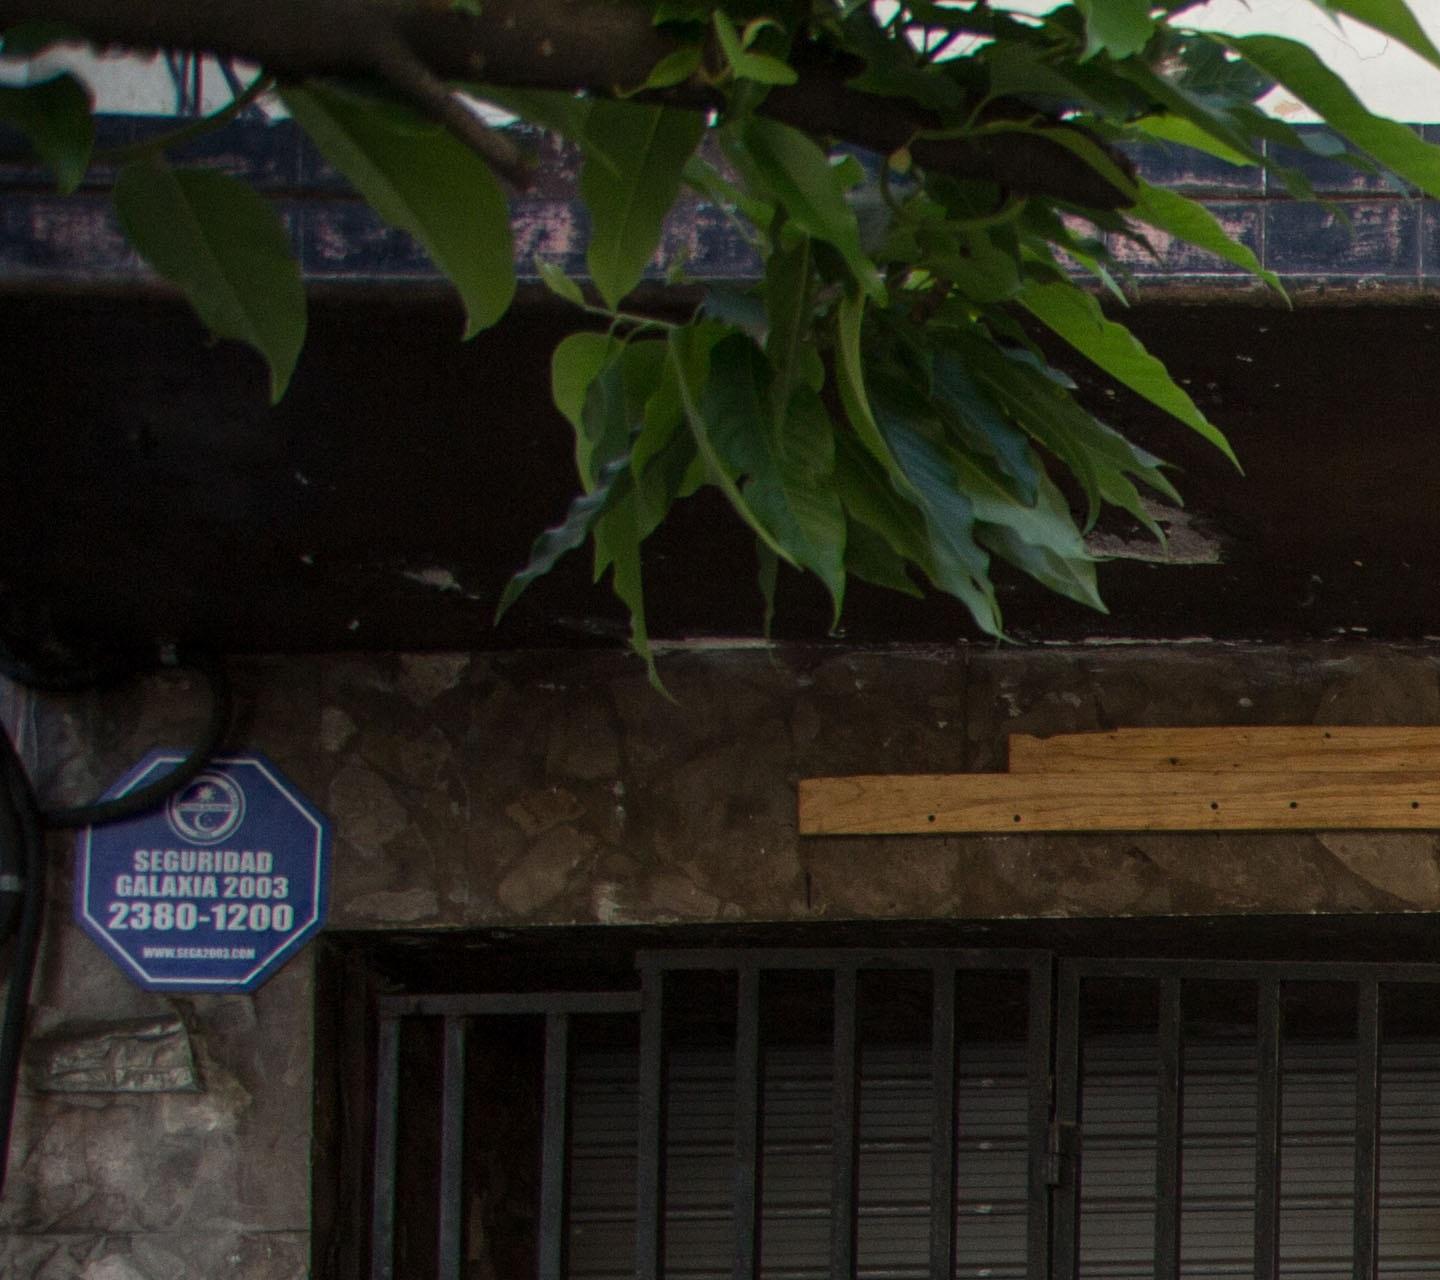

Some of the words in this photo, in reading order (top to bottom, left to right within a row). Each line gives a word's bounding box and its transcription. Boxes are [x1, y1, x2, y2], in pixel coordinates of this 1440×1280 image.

[133, 850, 274, 875] SEGURIDAD
[115, 874, 219, 898] GALAXIA
[222, 876, 290, 899] 2003
[107, 901, 296, 932] 2380-1200
